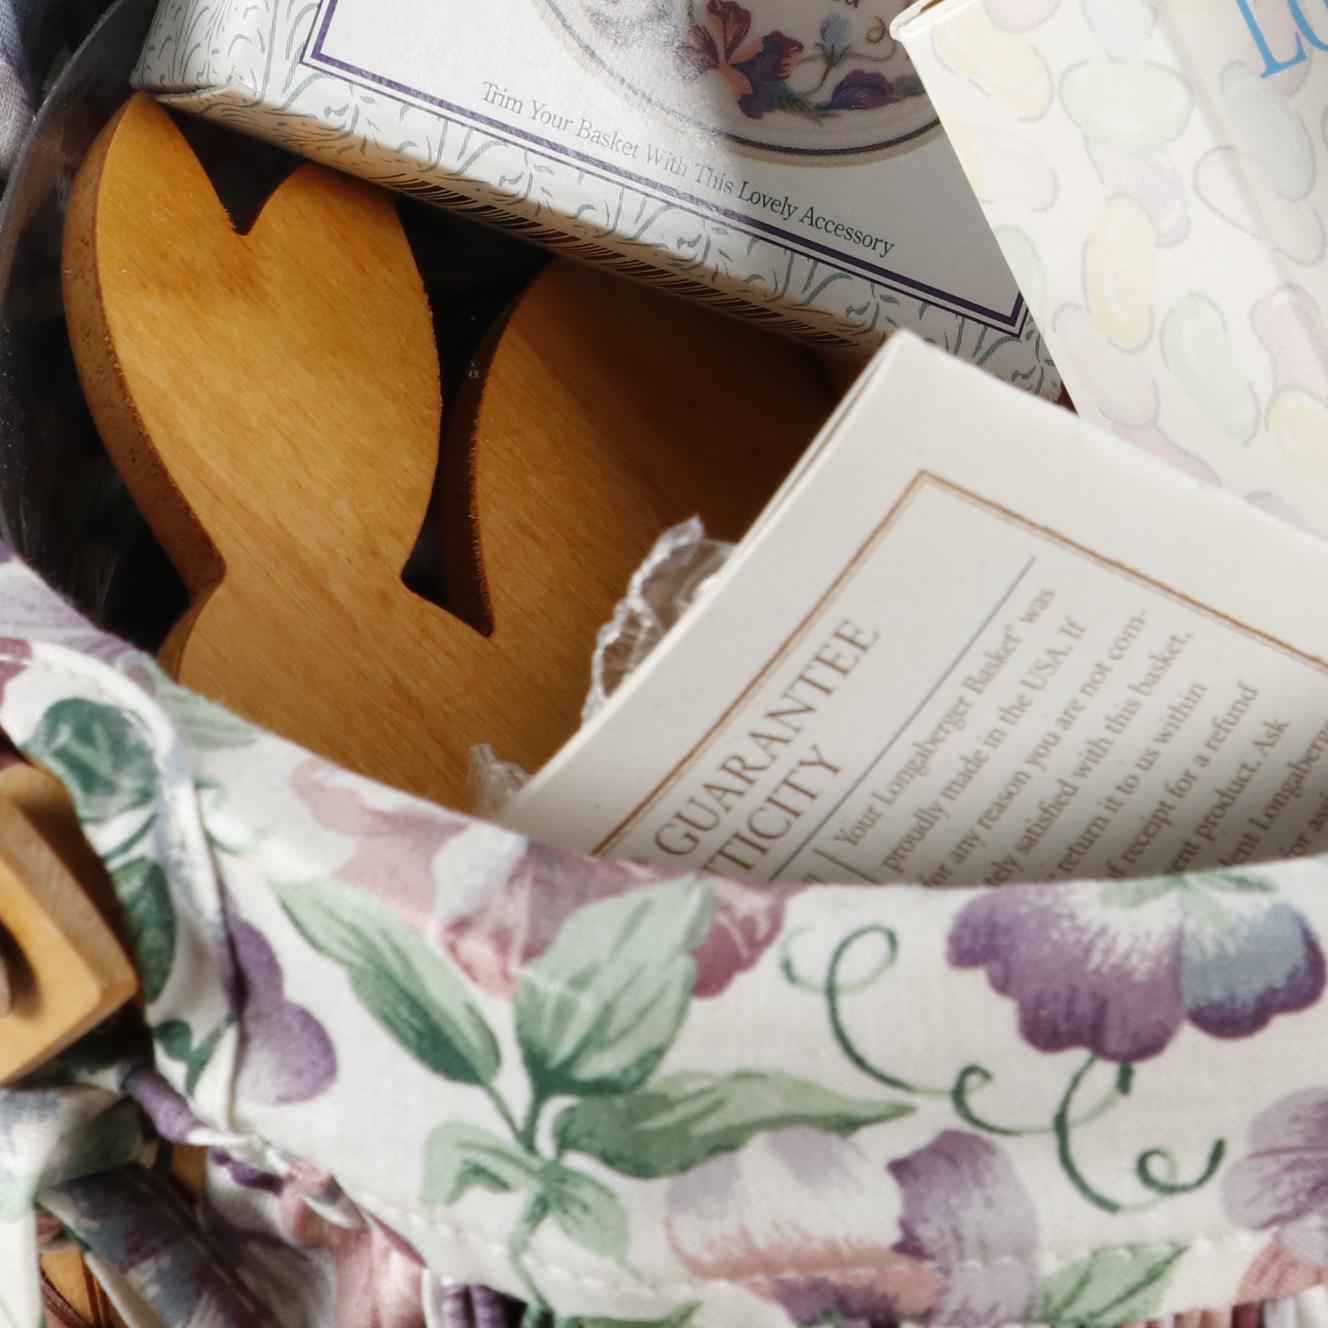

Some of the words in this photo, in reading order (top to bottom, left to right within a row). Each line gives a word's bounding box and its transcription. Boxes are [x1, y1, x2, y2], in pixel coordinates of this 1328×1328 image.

[482, 81, 524, 115] Trim
[529, 98, 573, 133] Your
[576, 117, 640, 160] Basket
[645, 143, 689, 179] With
[694, 161, 734, 196] This
[737, 180, 800, 222] Lovely
[799, 206, 896, 258] Accessory
[654, 620, 880, 857] GUARANTEE
[700, 744, 843, 874] TICITY
[833, 804, 883, 847] Your
[871, 694, 973, 807] Longaberger
[1020, 588, 1056, 625] was
[881, 800, 950, 874] proudly
[941, 748, 991, 802] made
[976, 727, 1008, 750] in
[998, 692, 1033, 726] the
[1059, 615, 1089, 642] If
[950, 827, 987, 865] any
[978, 770, 1034, 832] reason
[1025, 731, 1063, 773] you
[1055, 698, 1087, 732] are
[1079, 662, 1113, 698] not
[1107, 610, 1149, 662] com-
[1014, 777, 1080, 856] satisfied
[1072, 733, 1116, 780] with
[1103, 698, 1143, 736] this
[1057, 813, 1111, 875] return
[1096, 795, 1125, 815] it
[1114, 772, 1142, 796] to
[1134, 747, 1161, 773] us
[1152, 681, 1209, 748] within
[1120, 799, 1177, 866] receipt
[1163, 768, 1199, 800] for
[1193, 752, 1211, 768] a
[1204, 679, 1261, 753] refund
[1165, 839, 1201, 876] ent
[1194, 760, 1262, 844] product.
[1252, 718, 1291, 758] Ask
